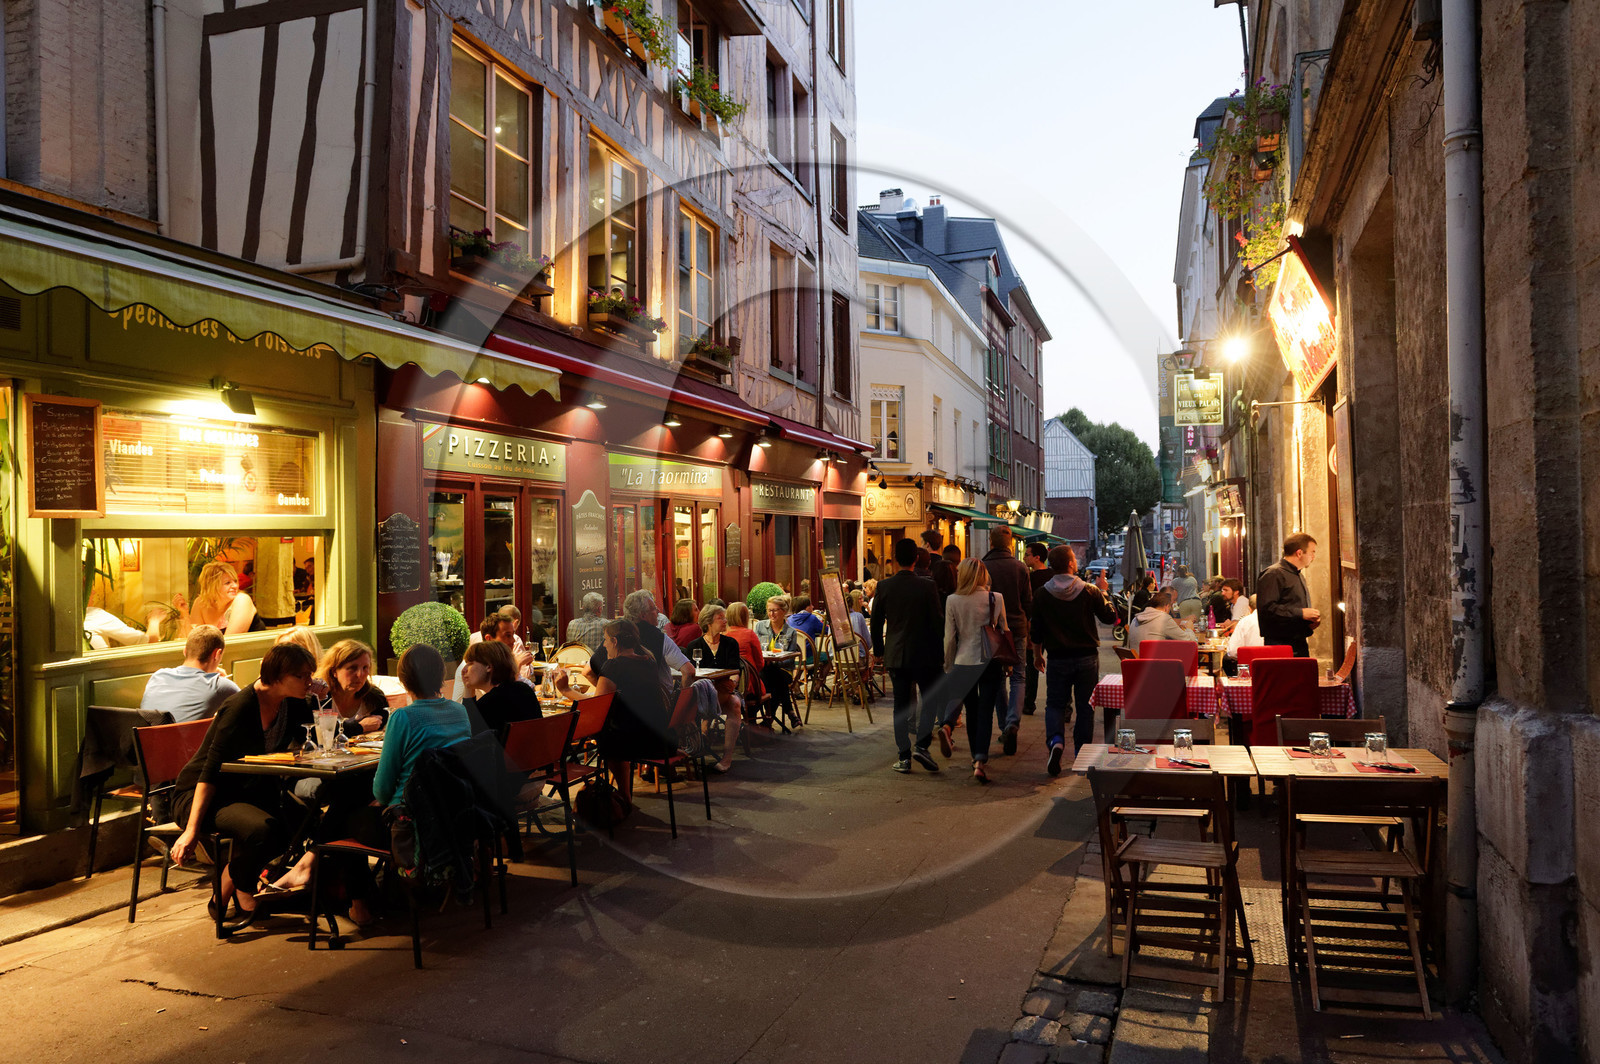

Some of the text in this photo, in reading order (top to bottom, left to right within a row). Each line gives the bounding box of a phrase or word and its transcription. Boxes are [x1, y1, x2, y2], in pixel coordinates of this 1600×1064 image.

[109, 438, 154, 456] Viandes
[448, 433, 550, 465] PIZZERIA
[467, 461, 492, 470] Cuisson
[503, 464, 513, 472] feu
[523, 466, 535, 474] bois
[277, 492, 311, 506] Gambas
[759, 483, 811, 502] RESTAURANT
[582, 578, 602, 591] SALLE
